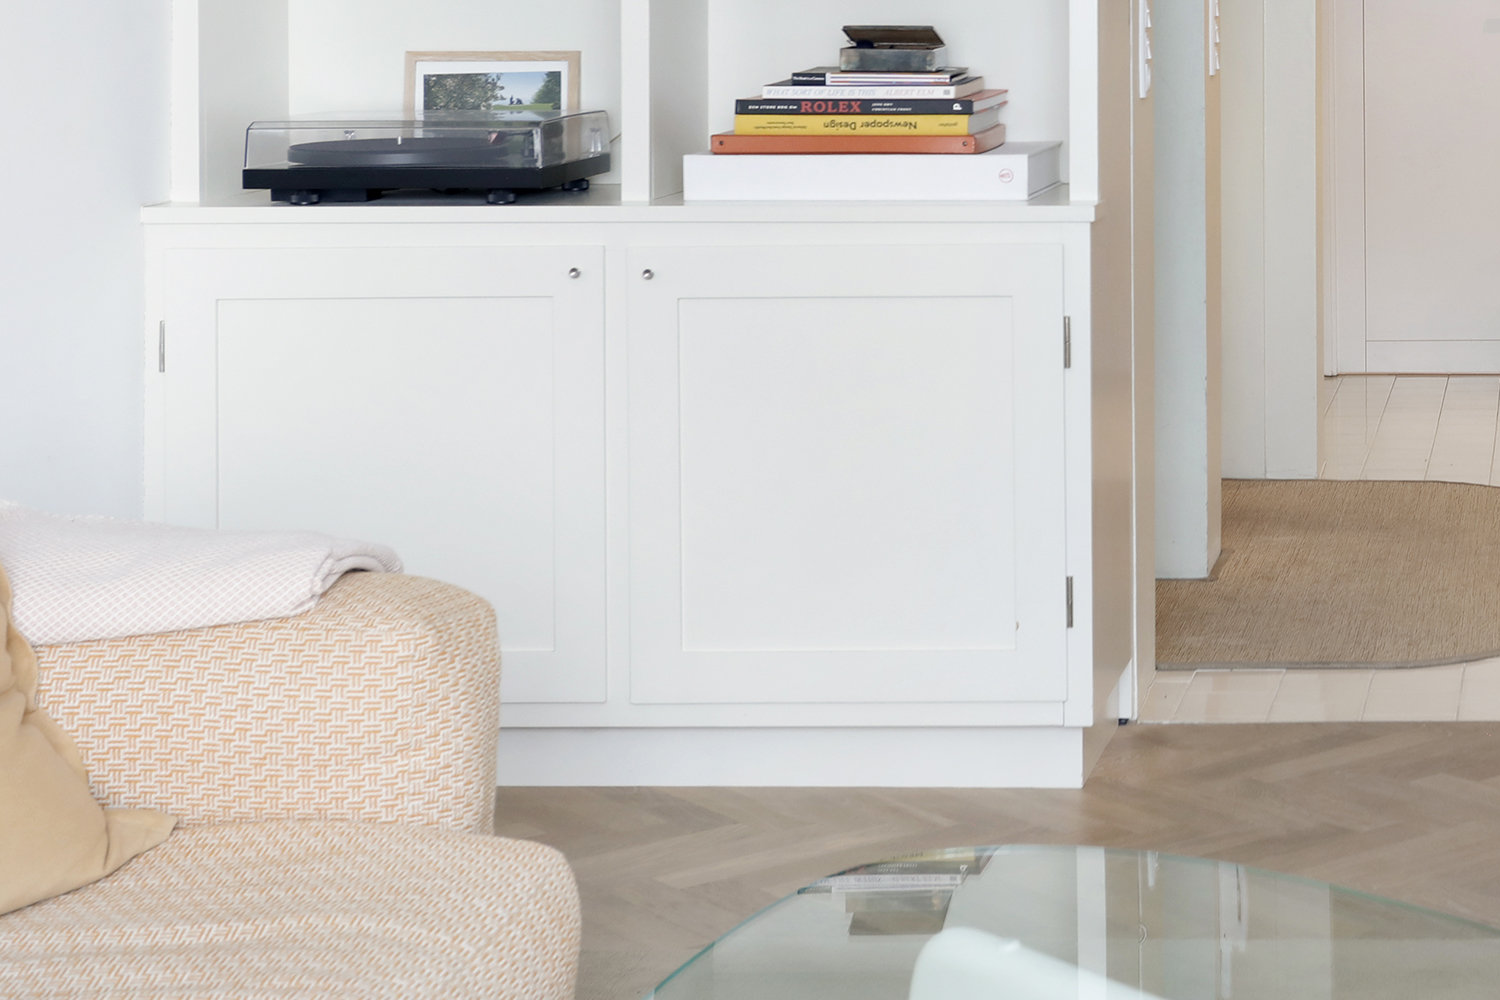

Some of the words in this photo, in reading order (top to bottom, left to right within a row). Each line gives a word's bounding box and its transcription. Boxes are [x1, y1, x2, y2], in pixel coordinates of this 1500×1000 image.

[800, 101, 861, 113] ROLEX
[823, 119, 857, 131] Design
[860, 119, 918, 130] Newspaper
